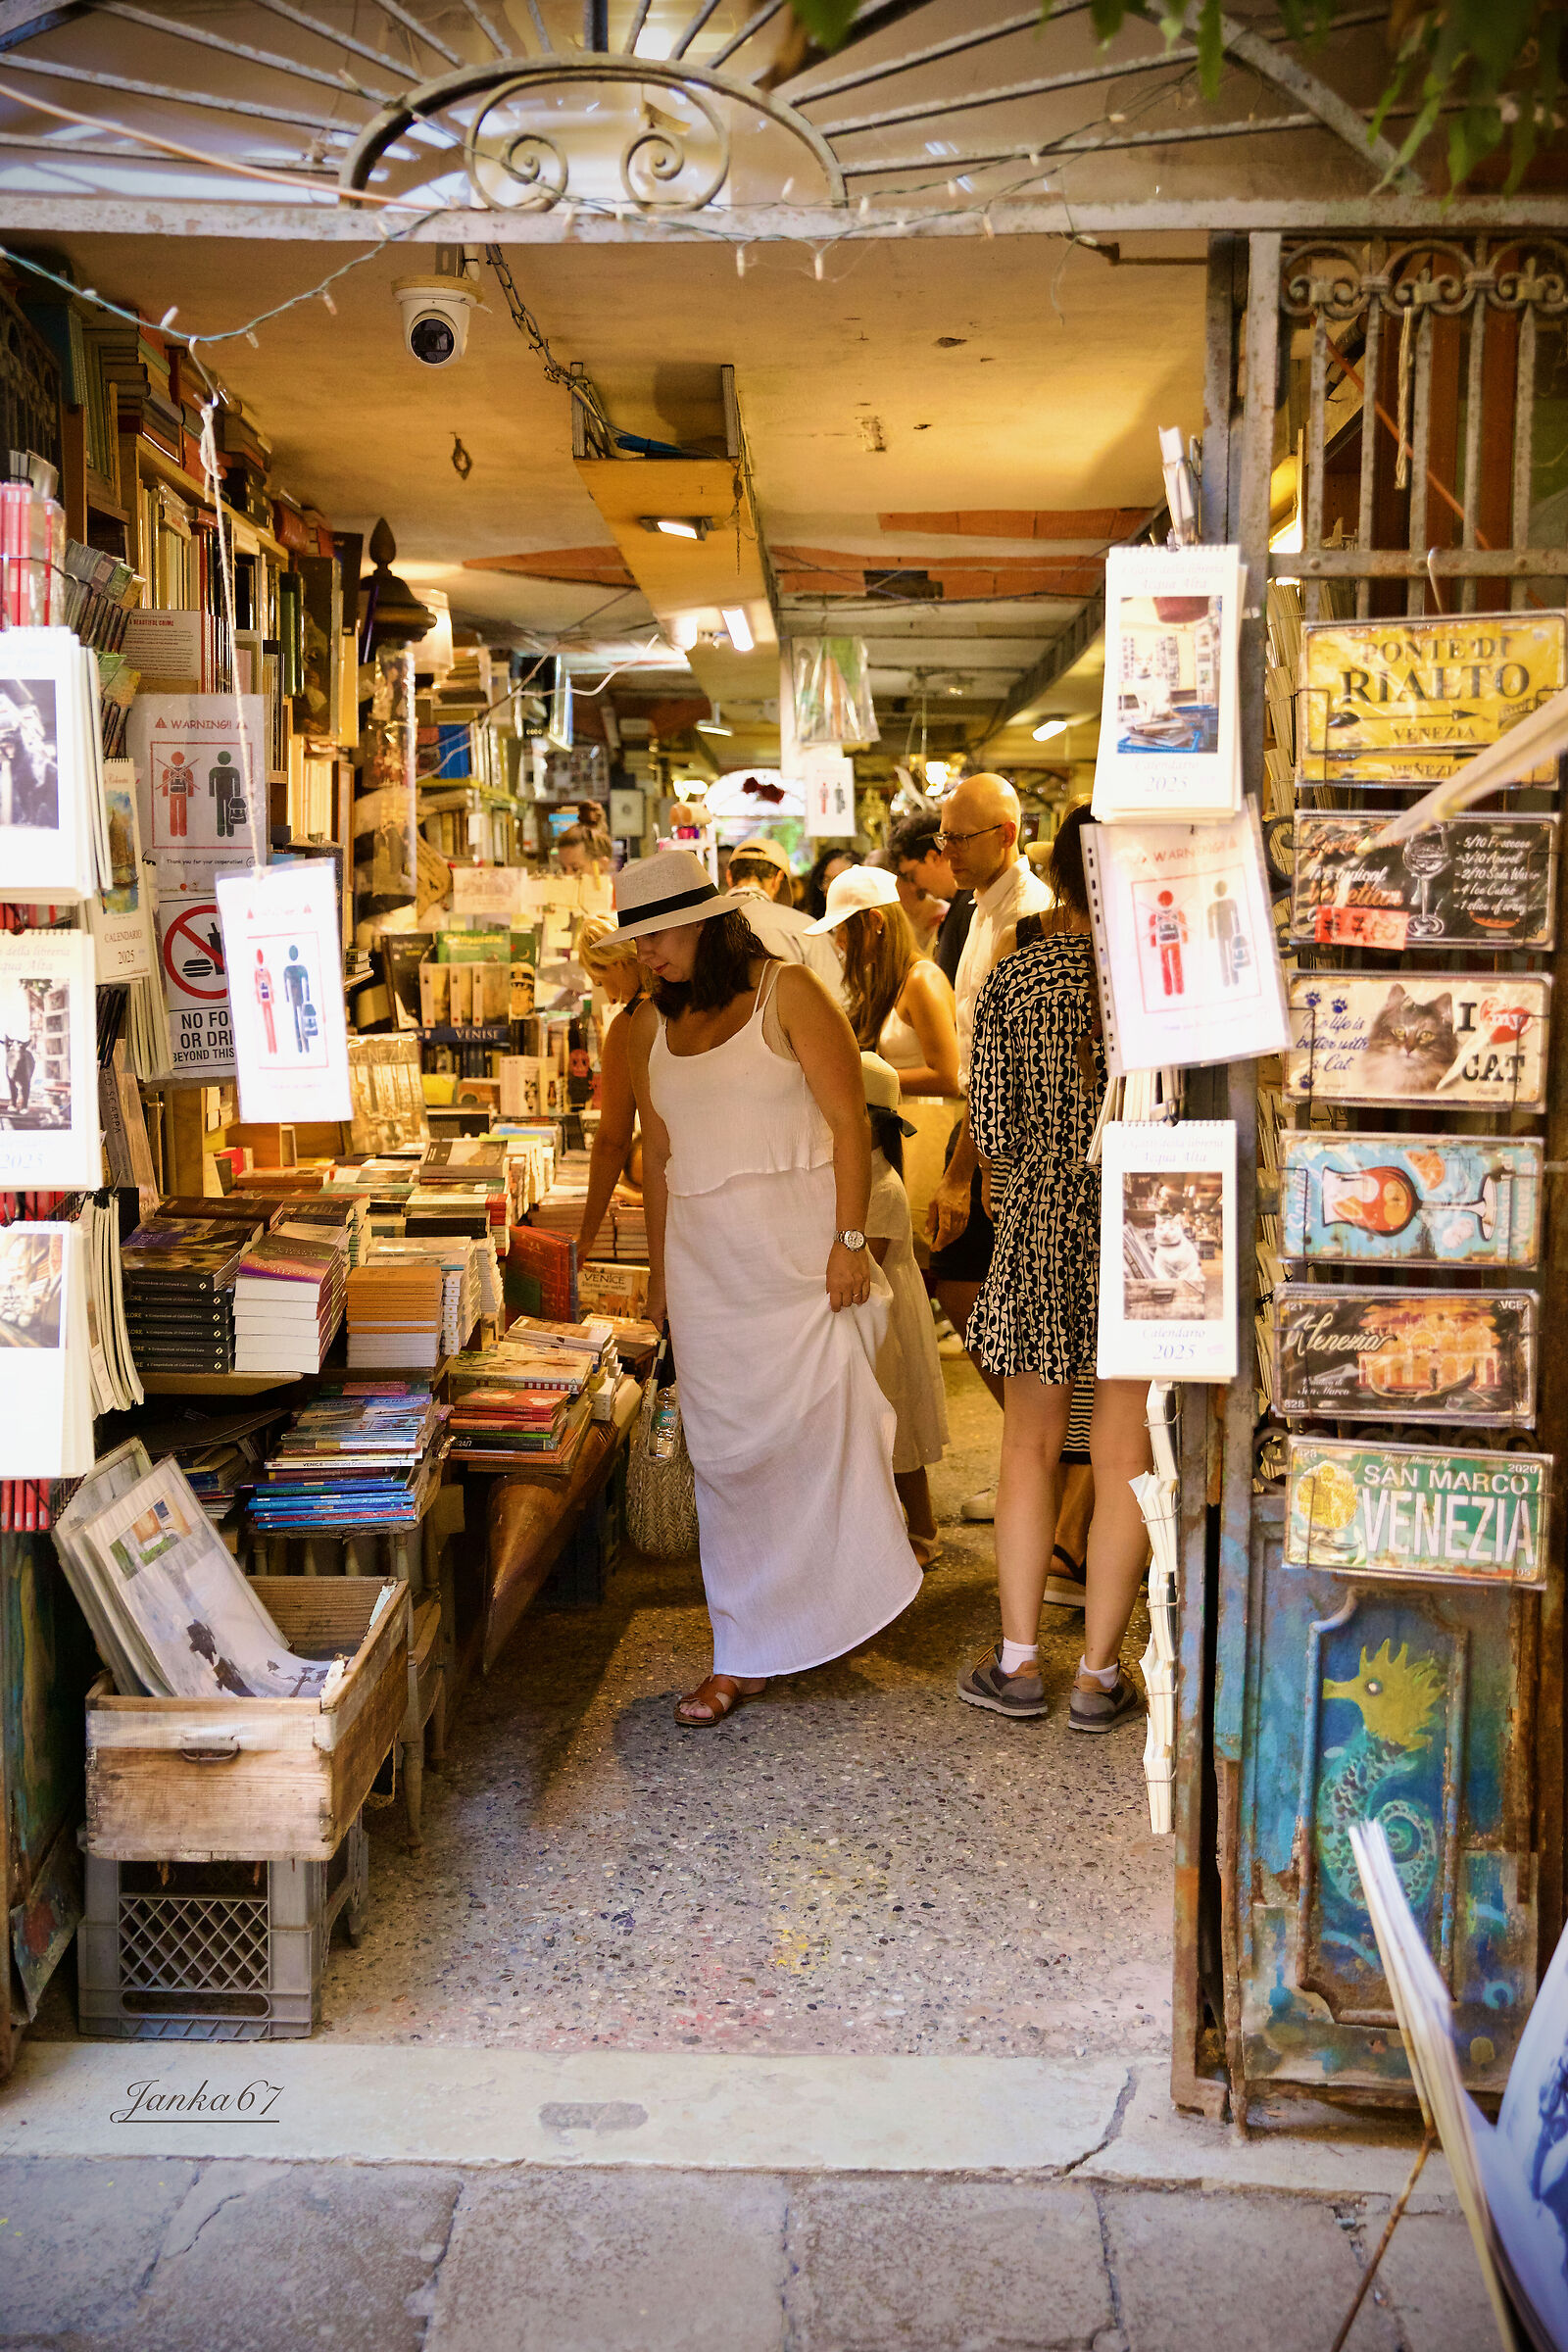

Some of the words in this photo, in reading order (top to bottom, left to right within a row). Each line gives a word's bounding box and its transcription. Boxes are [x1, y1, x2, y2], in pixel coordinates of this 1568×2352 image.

[1362, 637, 1466, 663] PONTE
[1476, 636, 1511, 659] DI
[1340, 663, 1530, 705] RIALTO
[1394, 726, 1477, 741] VENEZIA
[104, 929, 141, 943] CALENDARIO
[181, 1012, 203, 1029] NO
[209, 1011, 228, 1027] FO
[1457, 1003, 1478, 1032] I
[180, 1033, 202, 1049] OR
[207, 1030, 233, 1047] DRI
[455, 1029, 499, 1040] VENISE
[172, 1050, 210, 1062] BEYOND
[212, 1048, 235, 1058] THIS
[1324, 1054, 1354, 1072] Cat
[1461, 1054, 1525, 1082] CAT
[107, 1092, 122, 1134] SCARPA
[1499, 1300, 1524, 1310] VCE
[1282, 1312, 1398, 1356] Venezia
[1152, 1344, 1196, 1360] 2025
[1507, 1463, 1537, 1474] 2020
[1363, 1464, 1418, 1488] SAN
[1429, 1469, 1529, 1495] MARCO
[1362, 1488, 1536, 1565] VENEZIA
